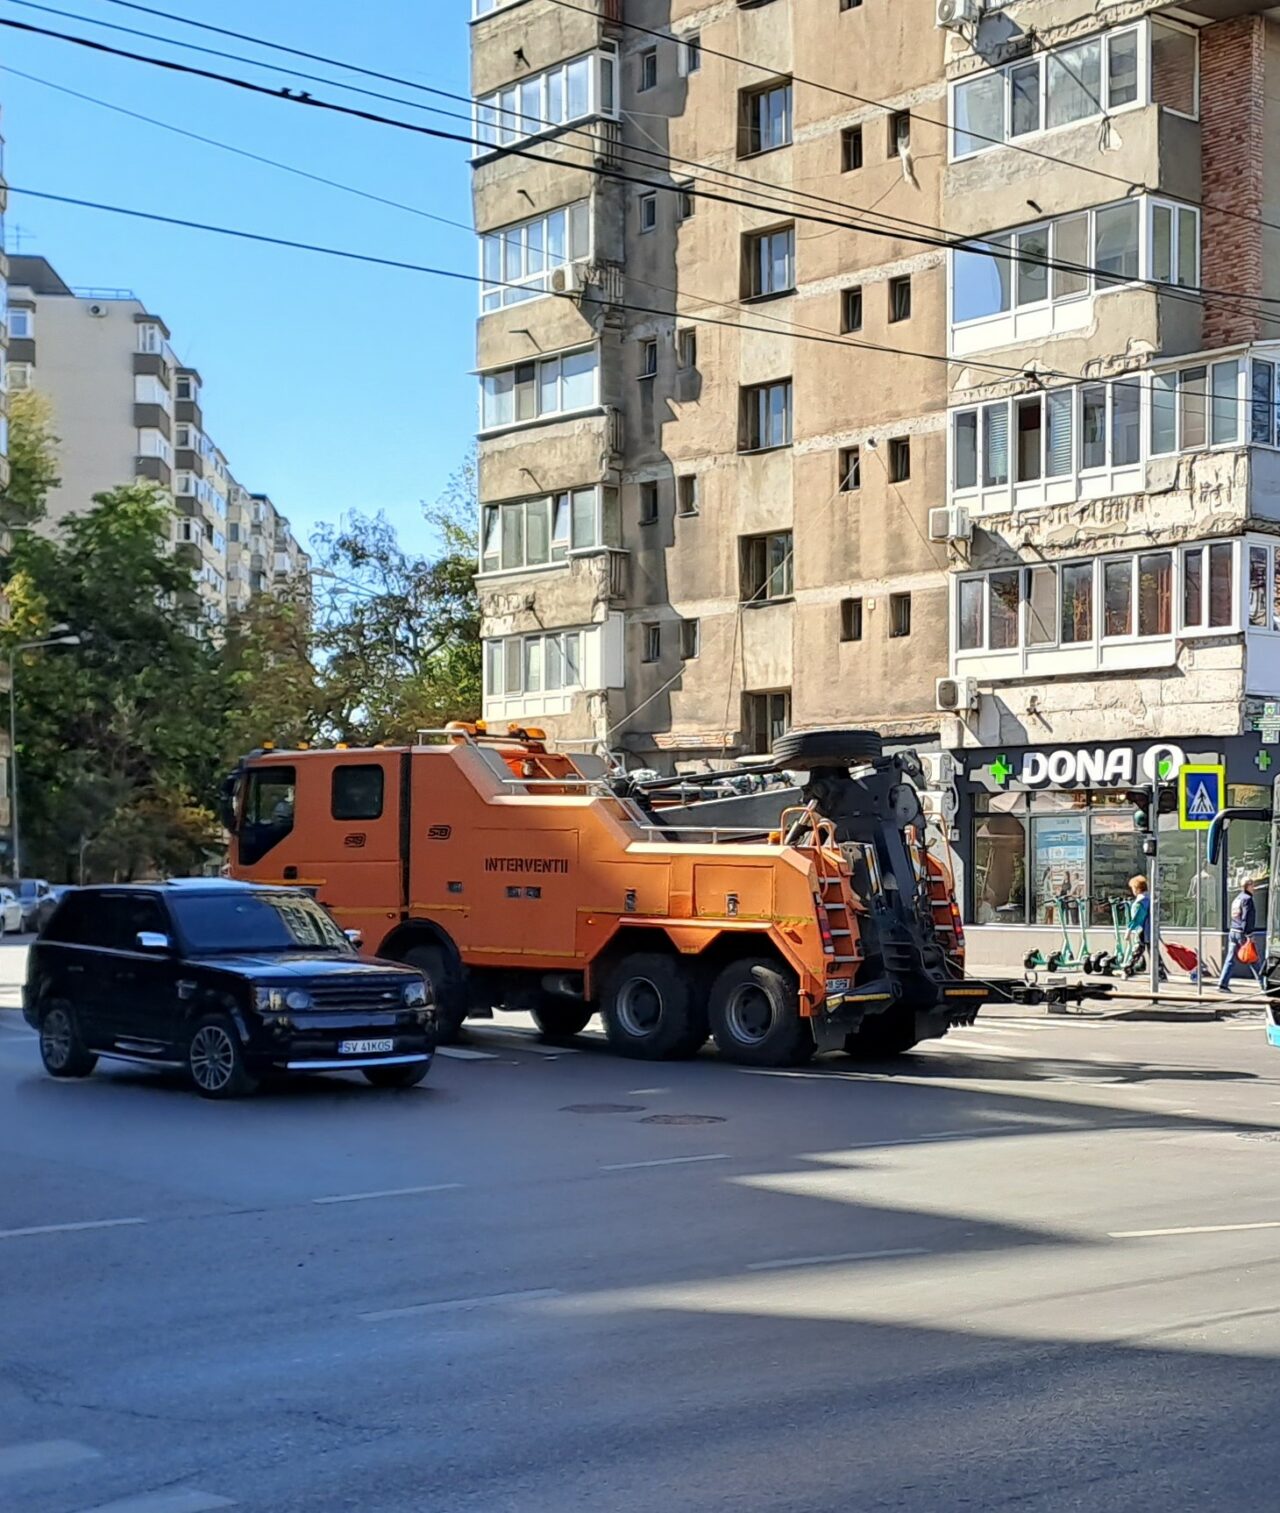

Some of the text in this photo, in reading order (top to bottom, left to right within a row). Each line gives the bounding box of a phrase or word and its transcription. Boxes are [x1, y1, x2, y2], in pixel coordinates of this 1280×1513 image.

[1022, 747, 1132, 784] DONA
[484, 857, 569, 874] INTERVENTII
[344, 1042, 358, 1052] SV
